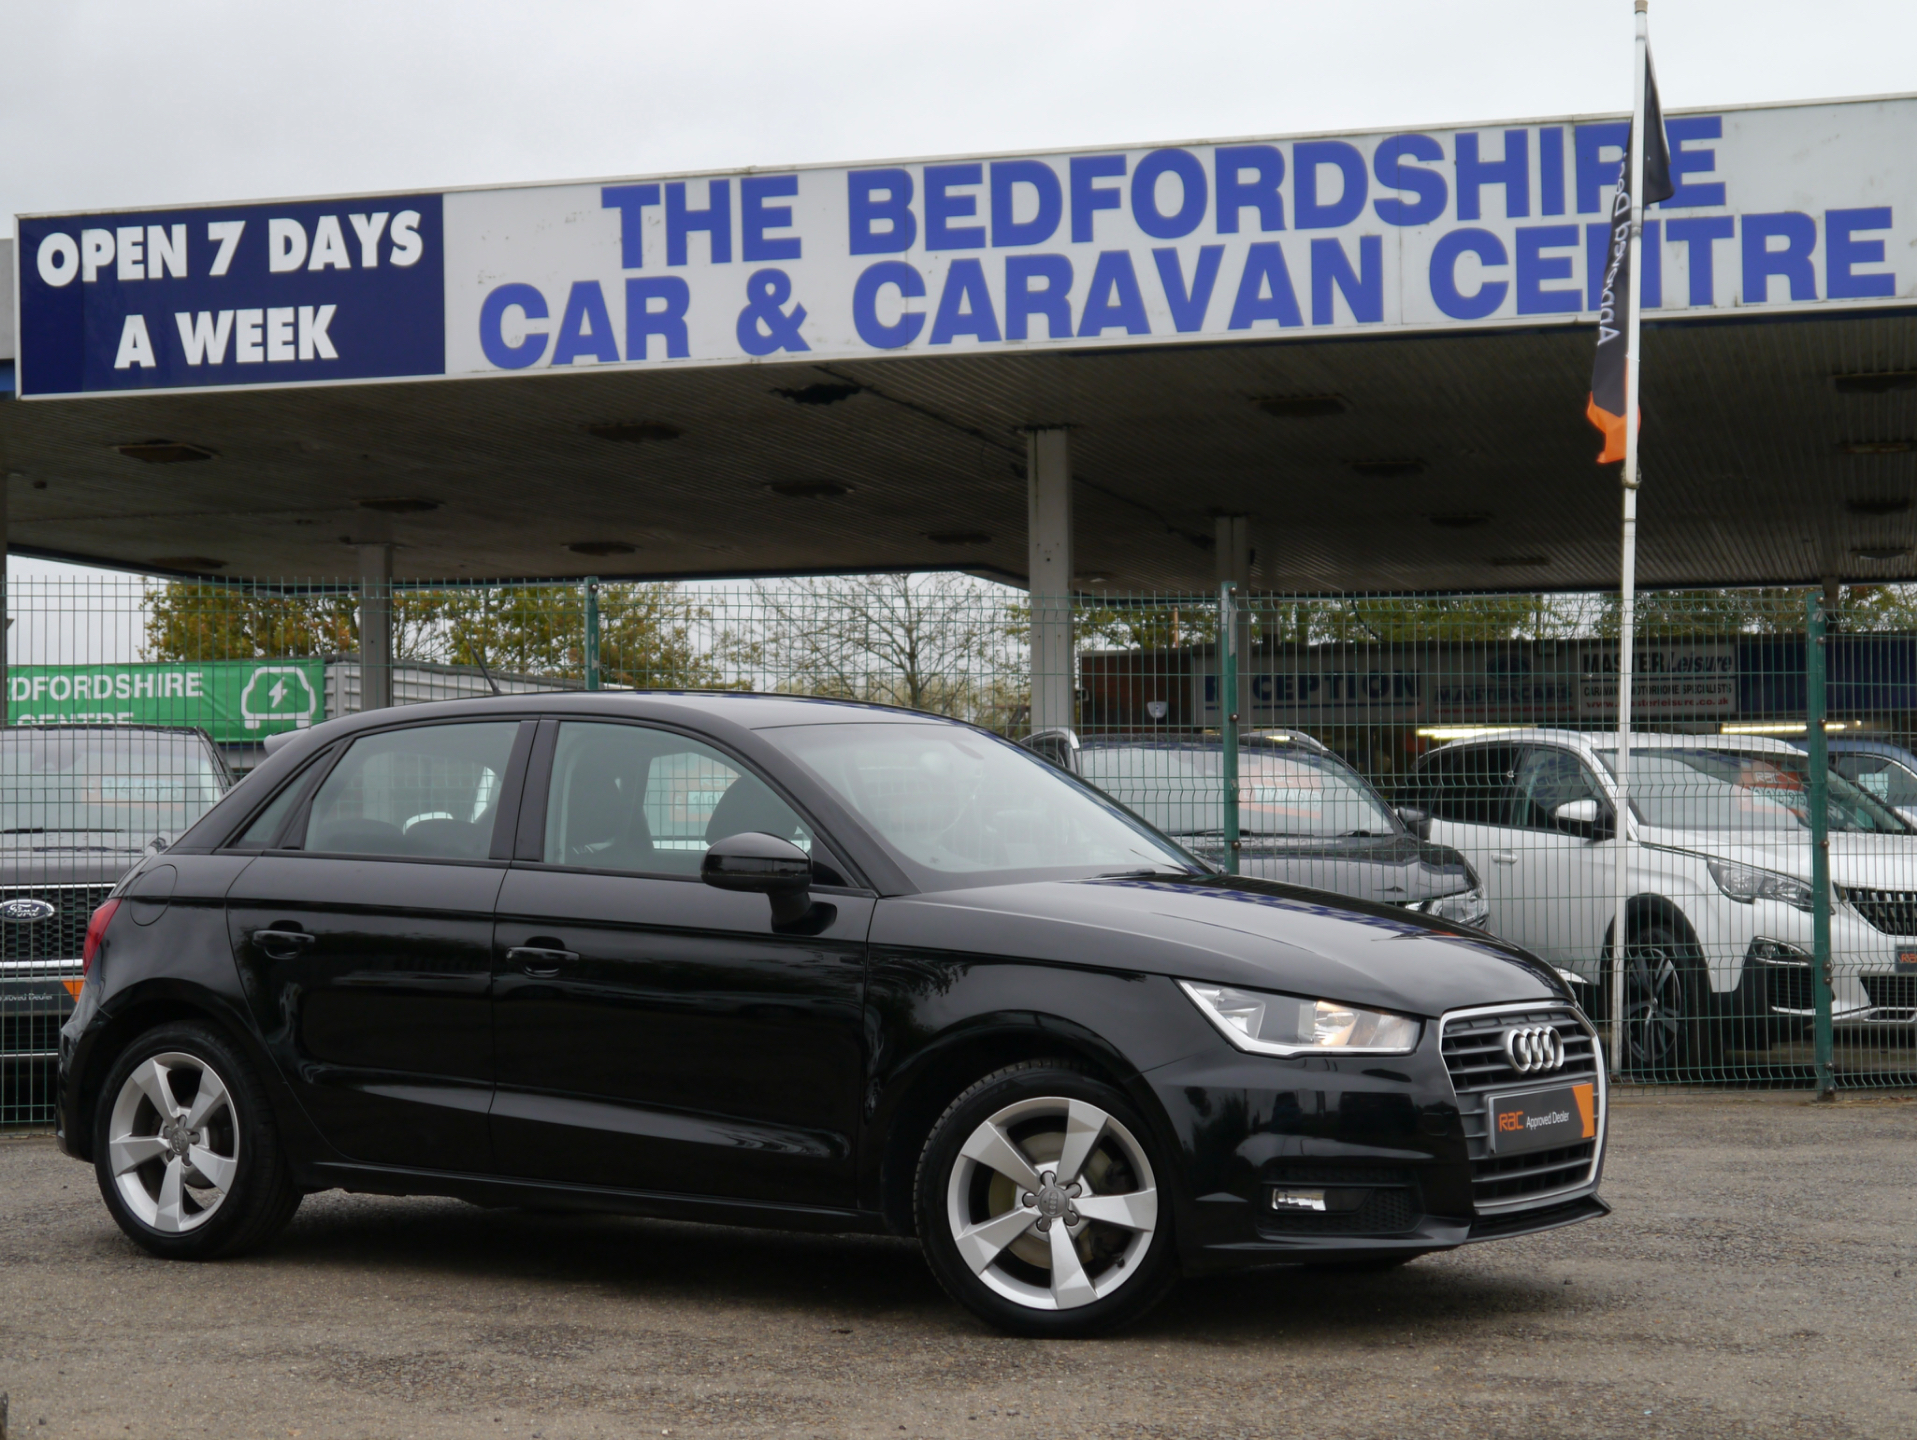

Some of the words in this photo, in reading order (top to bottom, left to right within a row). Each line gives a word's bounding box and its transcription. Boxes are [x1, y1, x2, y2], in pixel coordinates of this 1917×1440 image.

[601, 175, 802, 269] THE
[847, 115, 1726, 256] BEDFORDSHIRE
[36, 223, 188, 287] OPEN
[207, 220, 246, 276] 7
[268, 210, 424, 273] DAYS
[479, 275, 691, 369] CAR
[735, 268, 812, 356] &
[852, 235, 1384, 350] CARAVAN
[1429, 206, 1896, 321] CENTRE
[113, 314, 157, 370] A
[174, 304, 339, 366] WEEK
[1667, 651, 1733, 672] Leisure
[7, 672, 204, 701] DFORDSHIRE
[1682, 683, 1732, 694] SPECIALISTS
[1586, 697, 1729, 708] www.asterleisure.co.uk
[7, 903, 40, 918] Ford
[1526, 1112, 1551, 1131] Approved
[1552, 1110, 1570, 1124] Dealer
